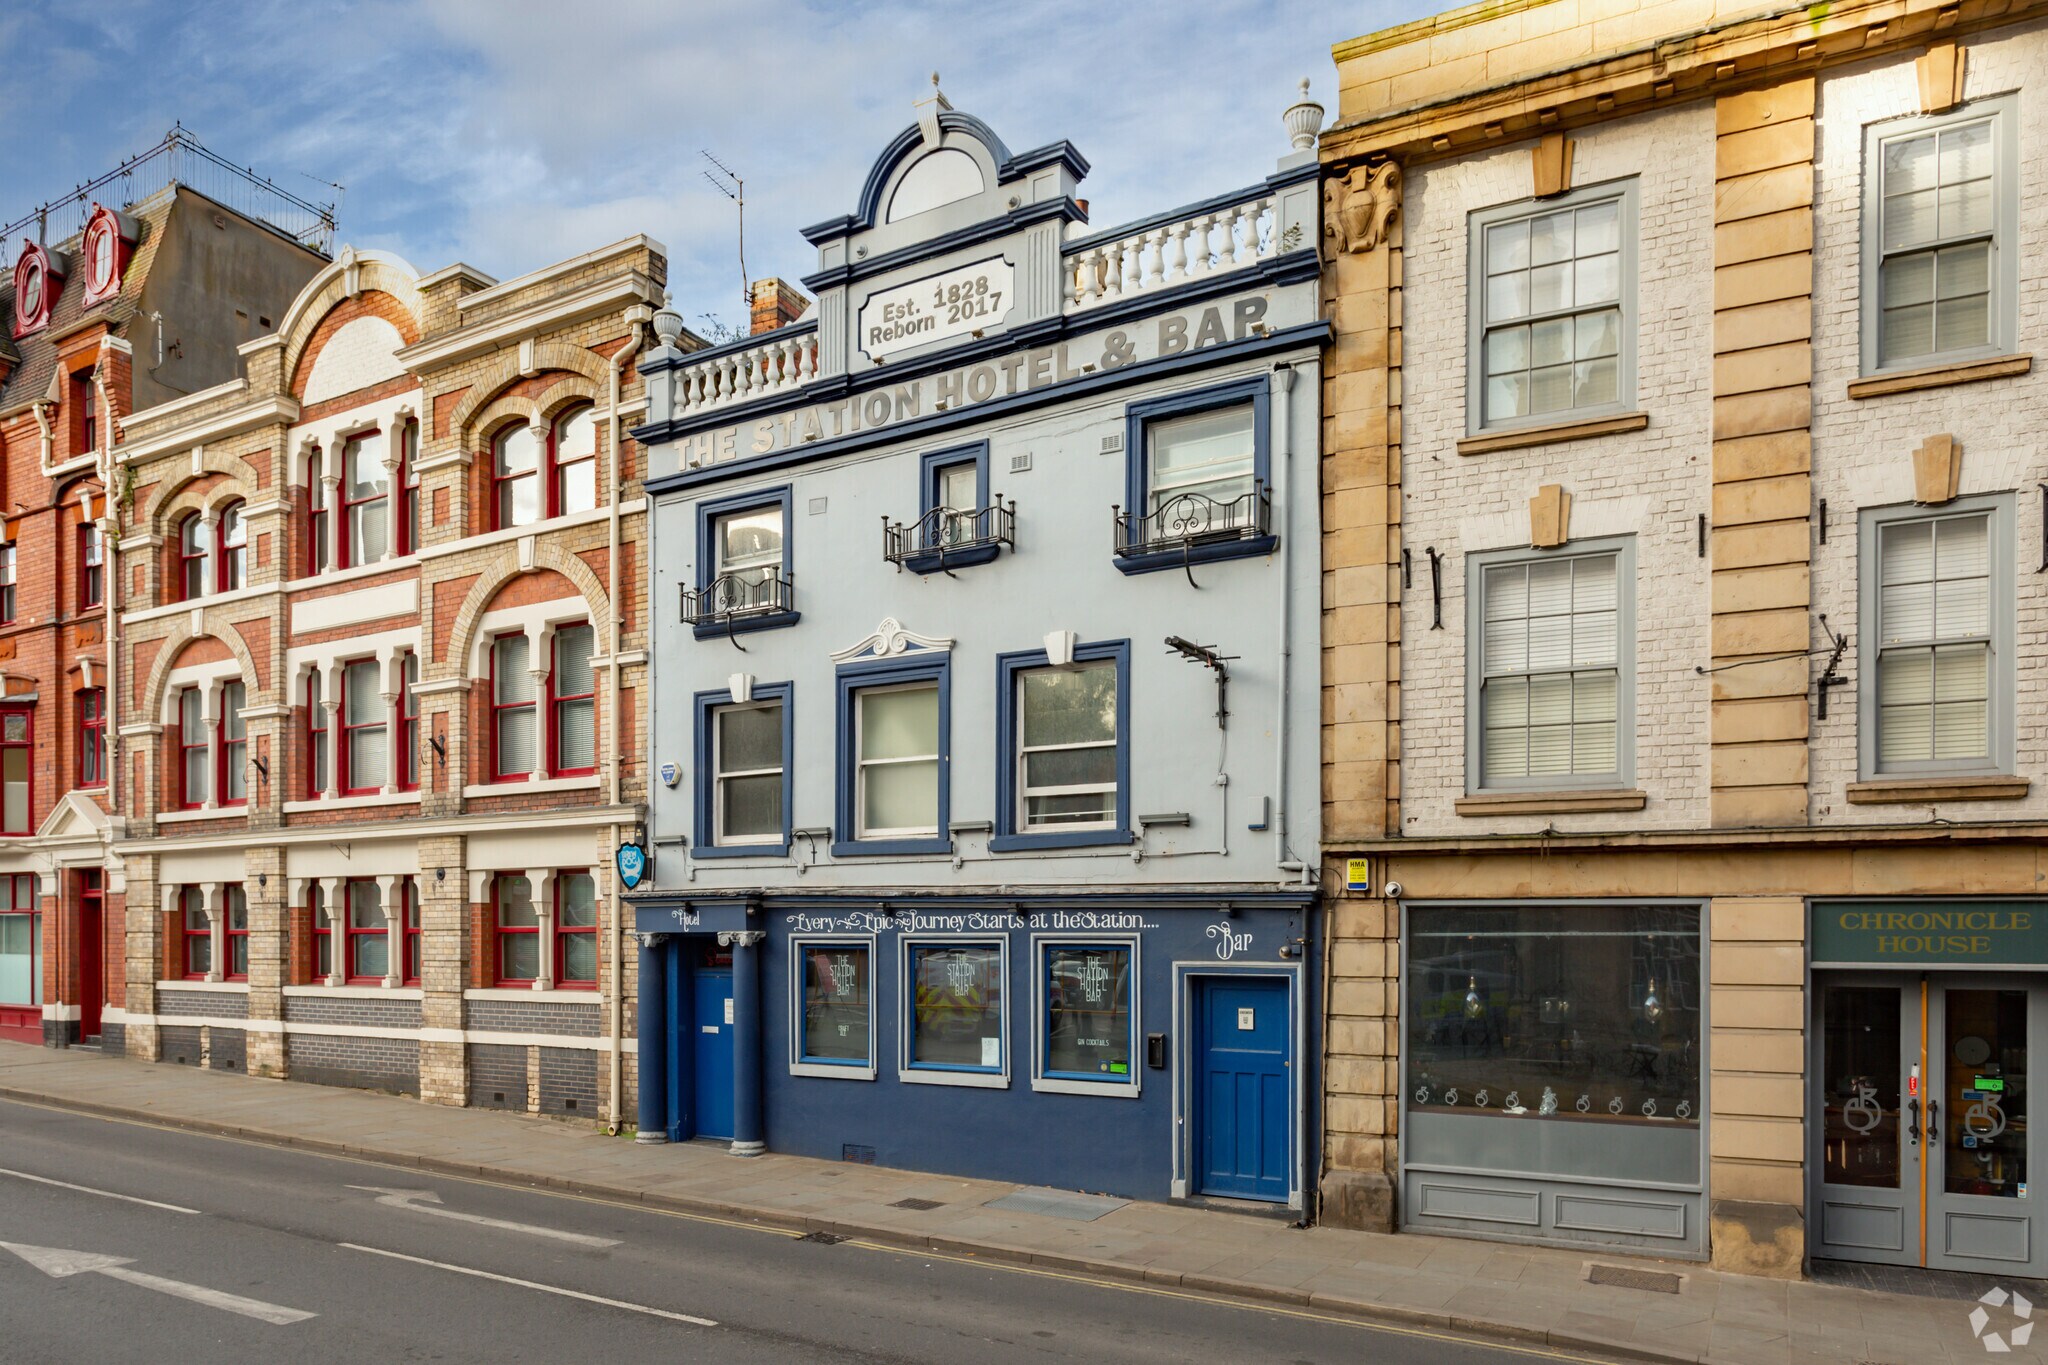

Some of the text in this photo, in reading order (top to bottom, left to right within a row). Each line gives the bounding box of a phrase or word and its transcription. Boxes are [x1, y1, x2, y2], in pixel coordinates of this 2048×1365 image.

[883, 276, 989, 323] Est. 1828
[870, 292, 1002, 346] Reborn 2017
[674, 296, 1268, 471] THE STATION HOTEL & BAR
[672, 909, 700, 932] Hotel
[786, 913, 837, 933] Every
[850, 911, 893, 933] Epic
[896, 909, 967, 933] Journey
[968, 912, 1024, 930] Starts
[1030, 913, 1048, 929] at
[1839, 912, 2032, 931] CHRONICLE
[1206, 921, 1253, 960] Bar
[1876, 936, 1992, 954] HOUSE
[837, 955, 850, 966] THE
[955, 953, 968, 965] THE
[1086, 956, 1101, 969] THE
[829, 964, 856, 977] STATION
[947, 963, 976, 976] STATION
[1077, 967, 1109, 980] STATION
[832, 975, 854, 987] HOTEL
[949, 974, 975, 987] HOTEL
[1080, 979, 1107, 991] HOTEL
[837, 984, 850, 996] BAR
[955, 984, 969, 997] BAR
[1085, 990, 1102, 1002] BAR
[1086, 1039, 1110, 1047] COCKTAILS
